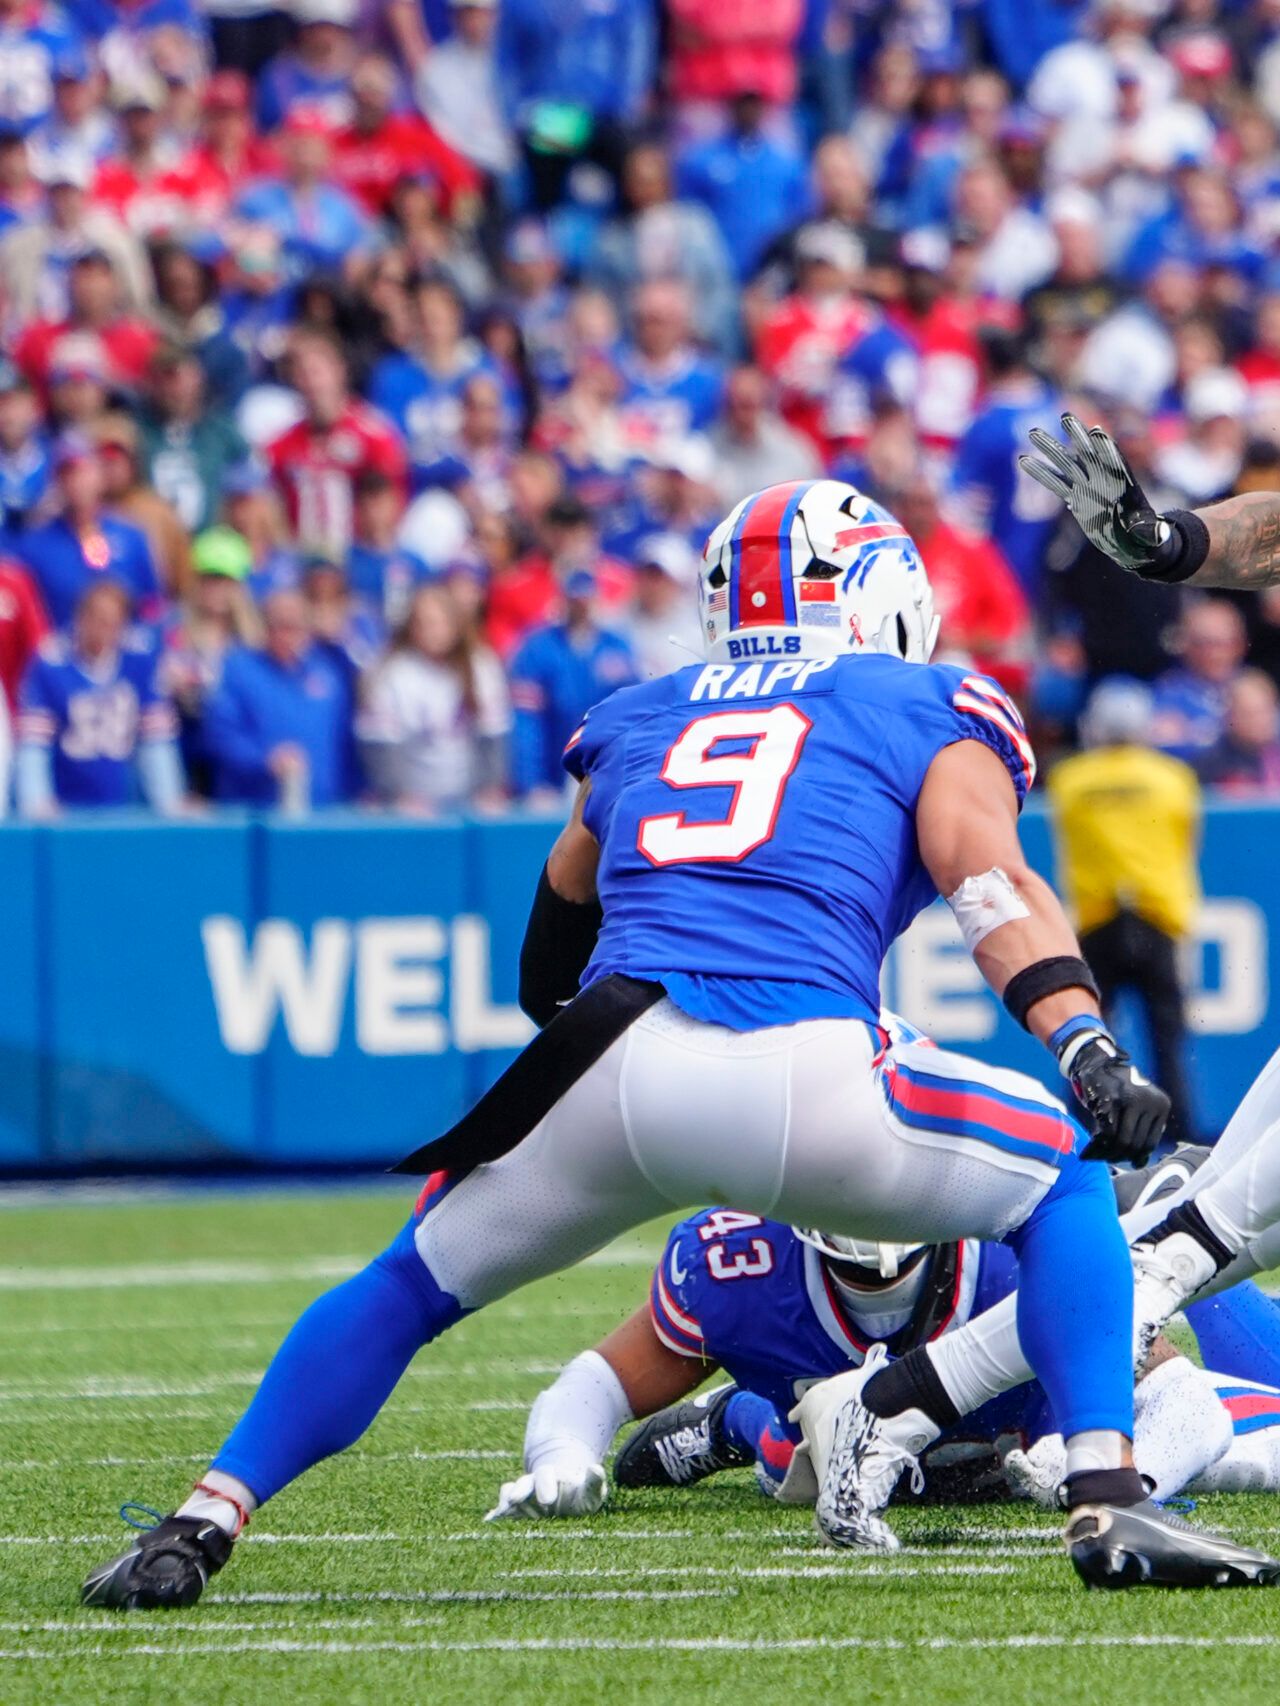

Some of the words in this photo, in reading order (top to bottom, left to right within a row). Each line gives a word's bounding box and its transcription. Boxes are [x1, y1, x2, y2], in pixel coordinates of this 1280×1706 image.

[727, 636, 801, 659] BILLS
[690, 656, 839, 701] RAPP
[636, 702, 815, 869] 9
[698, 1208, 775, 1281] 43
